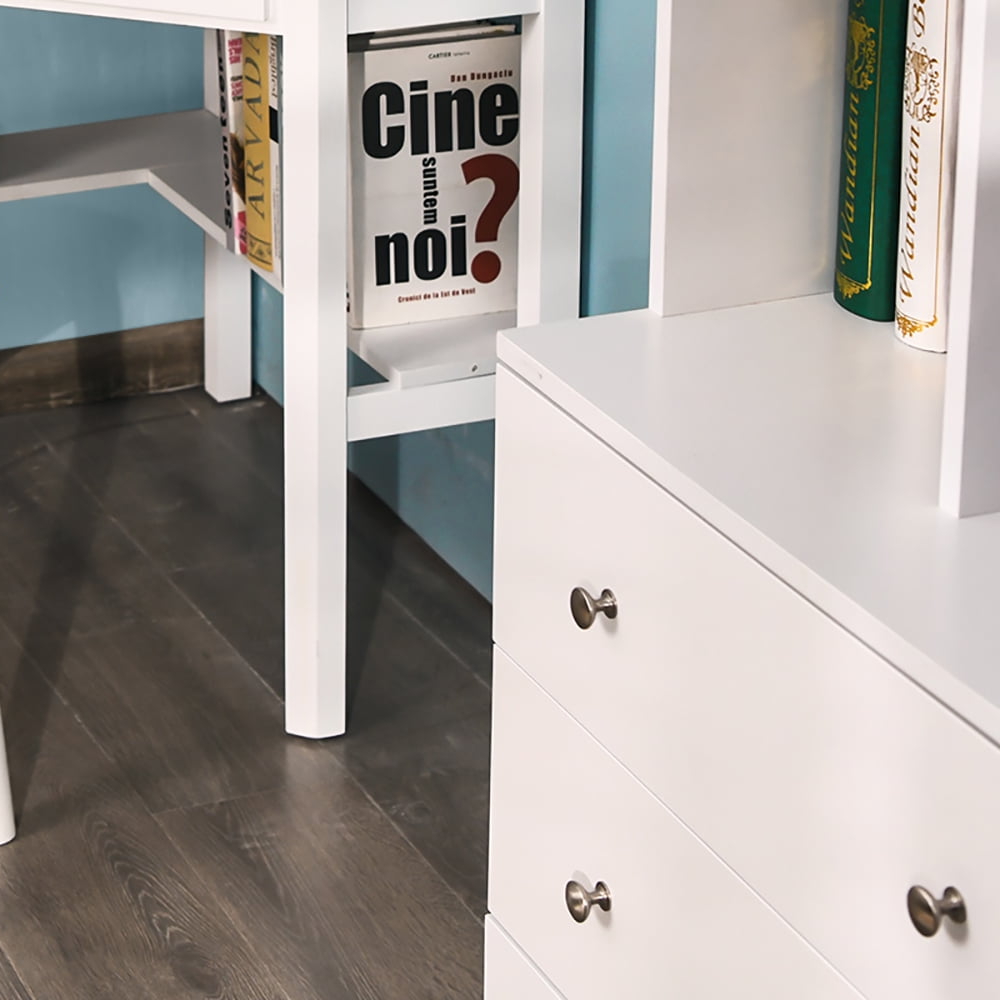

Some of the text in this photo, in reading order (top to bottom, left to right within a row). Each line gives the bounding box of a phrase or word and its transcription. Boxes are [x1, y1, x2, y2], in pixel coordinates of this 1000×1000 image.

[361, 79, 520, 160] Cine
[839, 94, 860, 266] Wandian
[422, 156, 439, 225] suntem
[898, 125, 921, 304] Wandian
